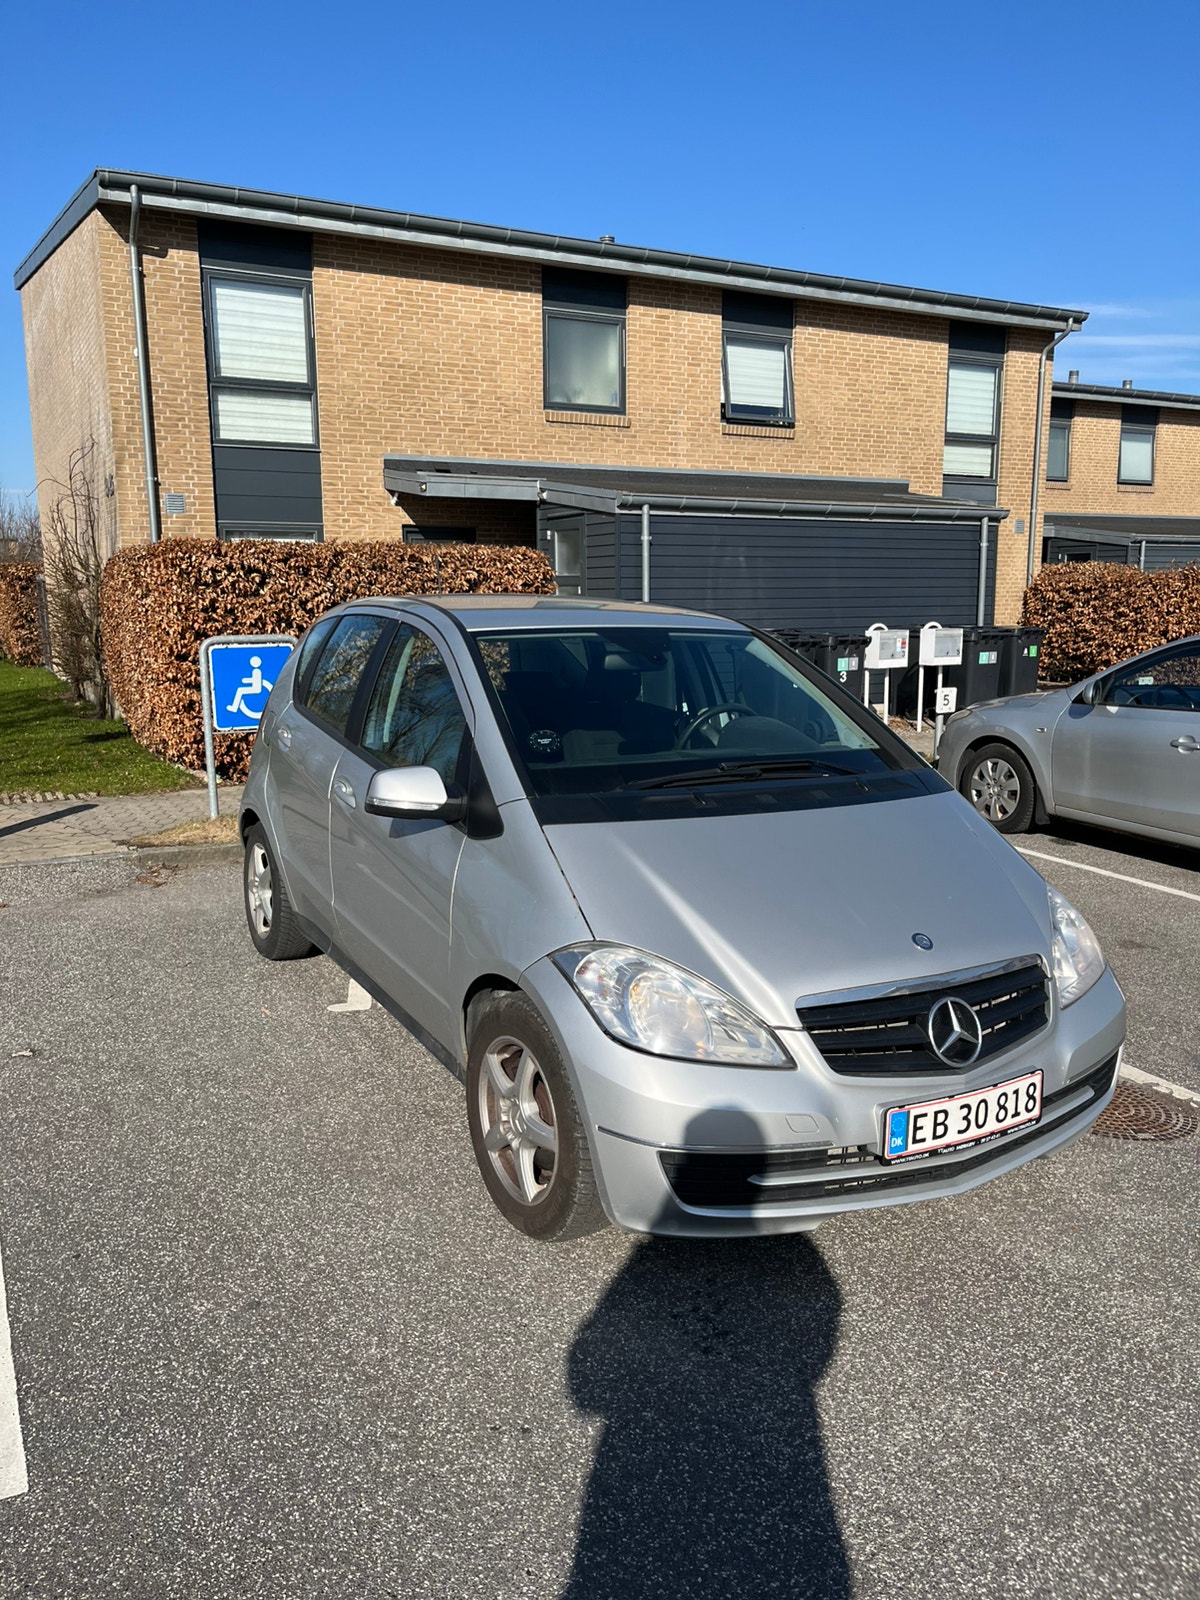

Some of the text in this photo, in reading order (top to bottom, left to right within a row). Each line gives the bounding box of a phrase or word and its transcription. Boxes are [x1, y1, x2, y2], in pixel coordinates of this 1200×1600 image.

[839, 671, 847, 683] 3
[942, 694, 950, 707] 5
[911, 1082, 1037, 1145] EB 30 818
[891, 1136, 903, 1148] DK
